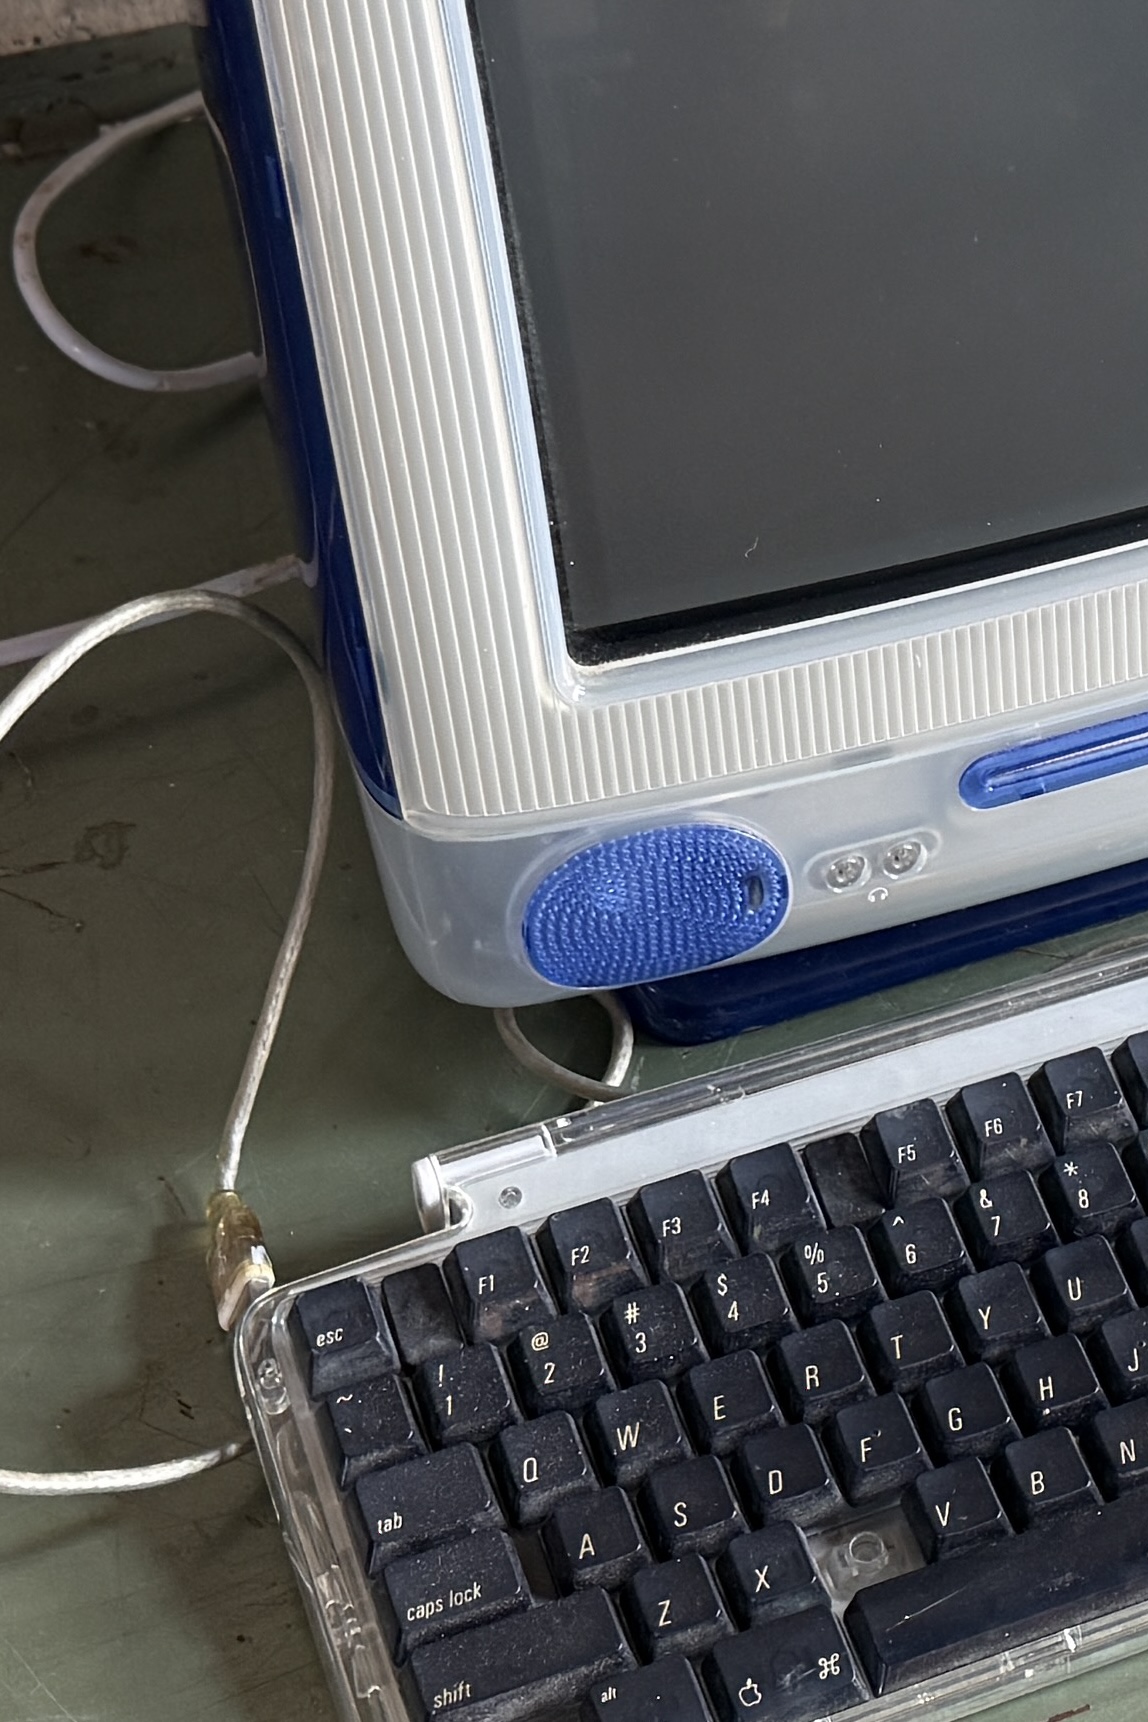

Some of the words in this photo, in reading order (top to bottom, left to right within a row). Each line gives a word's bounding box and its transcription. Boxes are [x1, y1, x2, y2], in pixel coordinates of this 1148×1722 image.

[1066, 1090, 1083, 1110] F7
[984, 1117, 1003, 1138] F6
[897, 1144, 916, 1164] F5
[751, 1189, 770, 1210] F4
[979, 1188, 993, 1209] &
[1078, 1188, 1089, 1209] 8
[662, 1216, 682, 1238] F3
[990, 1215, 1001, 1237] 7
[571, 1245, 590, 1267] F2
[804, 1242, 825, 1266] %
[905, 1243, 917, 1265] 6
[478, 1274, 494, 1295] F1
[717, 1273, 728, 1297] $
[817, 1271, 829, 1294] 5
[1067, 1276, 1082, 1301] U
[624, 1301, 640, 1325] #
[727, 1300, 739, 1321] 4
[978, 1305, 991, 1330] Y
[316, 1327, 344, 1347] esc
[531, 1331, 549, 1352] @
[635, 1331, 647, 1354] 3
[890, 1334, 904, 1360] T
[1127, 1347, 1139, 1372] J
[438, 1364, 444, 1388] !
[543, 1362, 556, 1385] 2
[805, 1365, 820, 1390] R
[1038, 1375, 1054, 1401] H
[445, 1394, 452, 1416] 1
[713, 1394, 726, 1421] E
[948, 1407, 963, 1432] G
[616, 1421, 640, 1451] W
[860, 1436, 872, 1463] F
[1119, 1438, 1136, 1465] N
[523, 1456, 539, 1483] Q
[768, 1469, 783, 1495] D
[1030, 1470, 1045, 1496] B
[377, 1511, 403, 1535] tab
[673, 1501, 688, 1528] S
[935, 1501, 950, 1527] V
[578, 1533, 595, 1560] A
[754, 1565, 771, 1593] X
[406, 1598, 444, 1622] caps
[449, 1581, 482, 1608] lock
[657, 1599, 672, 1627] Z
[433, 1680, 471, 1709] shift
[601, 1686, 617, 1703] alt
